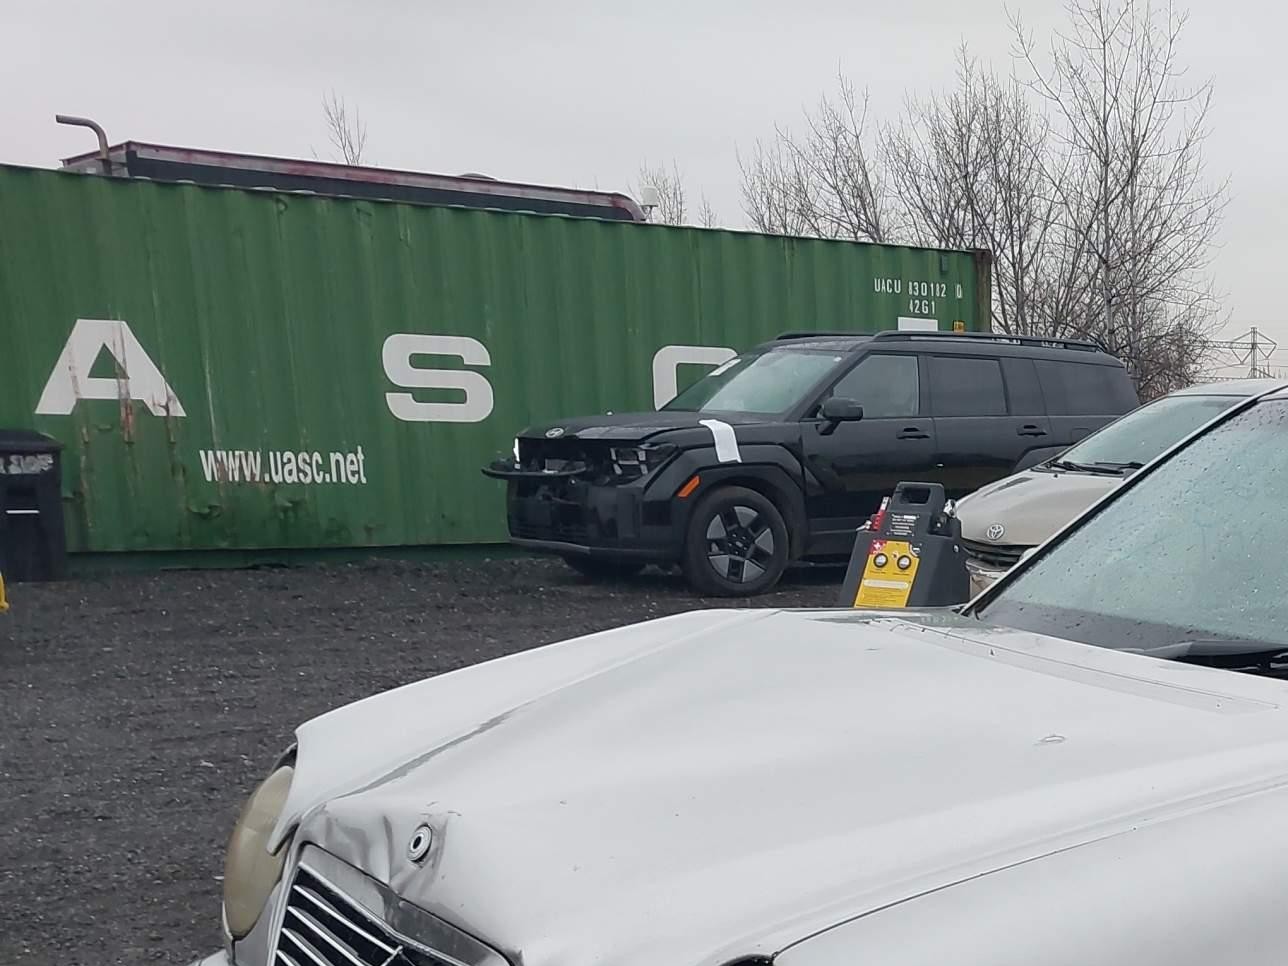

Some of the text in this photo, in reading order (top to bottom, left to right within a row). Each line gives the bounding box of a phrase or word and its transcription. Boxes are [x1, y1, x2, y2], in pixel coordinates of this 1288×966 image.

[874, 278, 901, 294] UACU
[909, 281, 946, 297] 830182
[909, 299, 935, 315] 42G1
[35, 318, 187, 417] A
[382, 333, 495, 423] S
[199, 445, 368, 485] www.uasc.net
